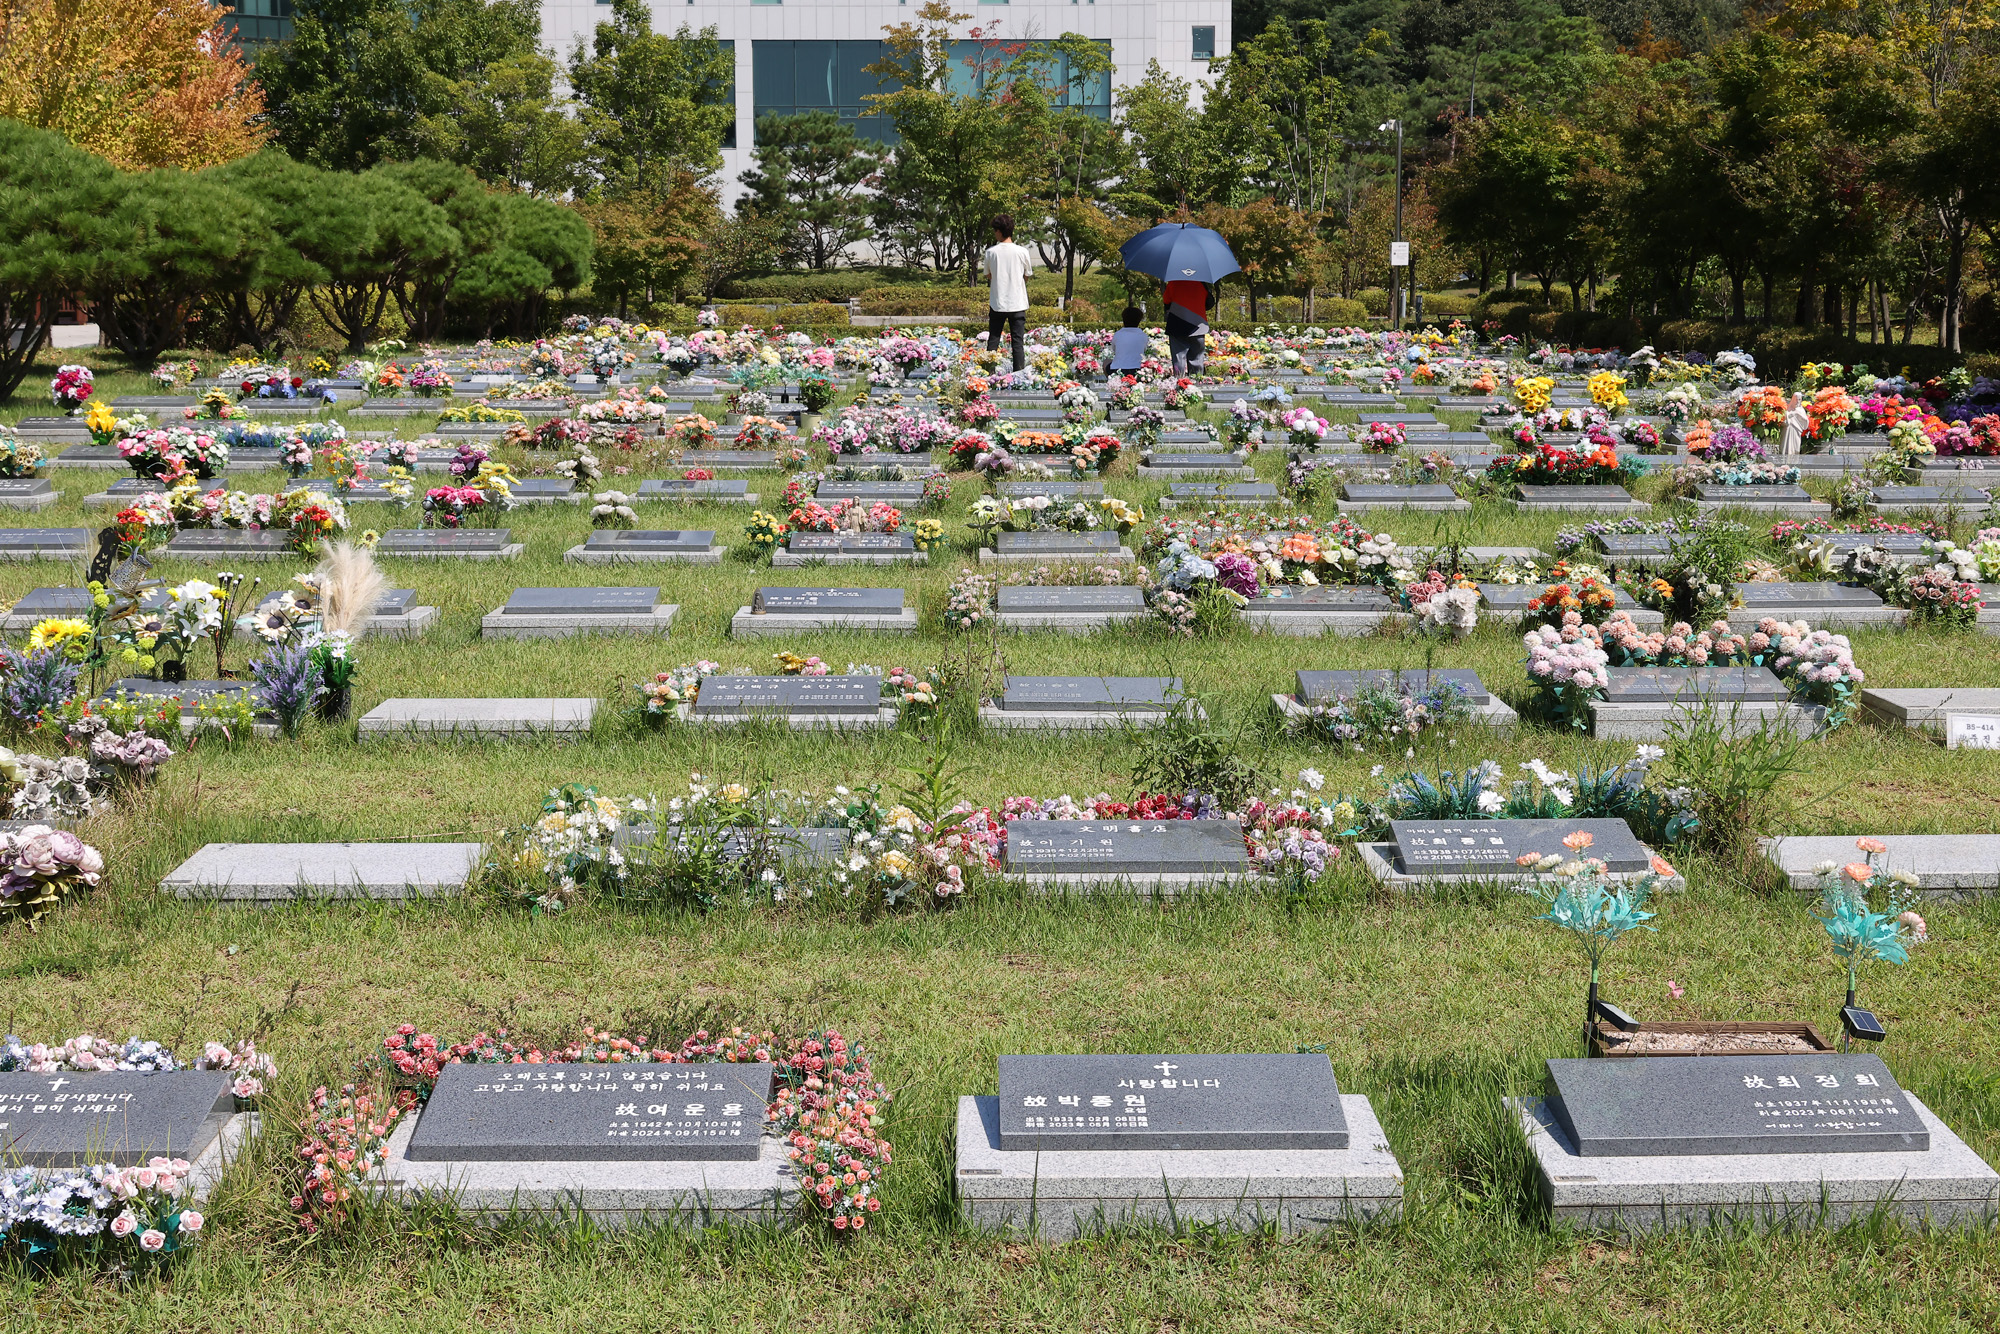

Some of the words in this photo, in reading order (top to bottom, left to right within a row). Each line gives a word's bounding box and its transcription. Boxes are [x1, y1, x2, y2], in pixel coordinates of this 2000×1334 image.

[498, 1071, 566, 1081] 오래도록
[579, 1071, 611, 1081] 잊지
[622, 1071, 708, 1081] 않겠습니다
[473, 1083, 524, 1093] 고맙고
[533, 1083, 619, 1093] 사랑합니다
[631, 1083, 664, 1093] 편히
[676, 1082, 726, 1092] 쉬세요
[1117, 1079, 1221, 1089] 사랑합니다
